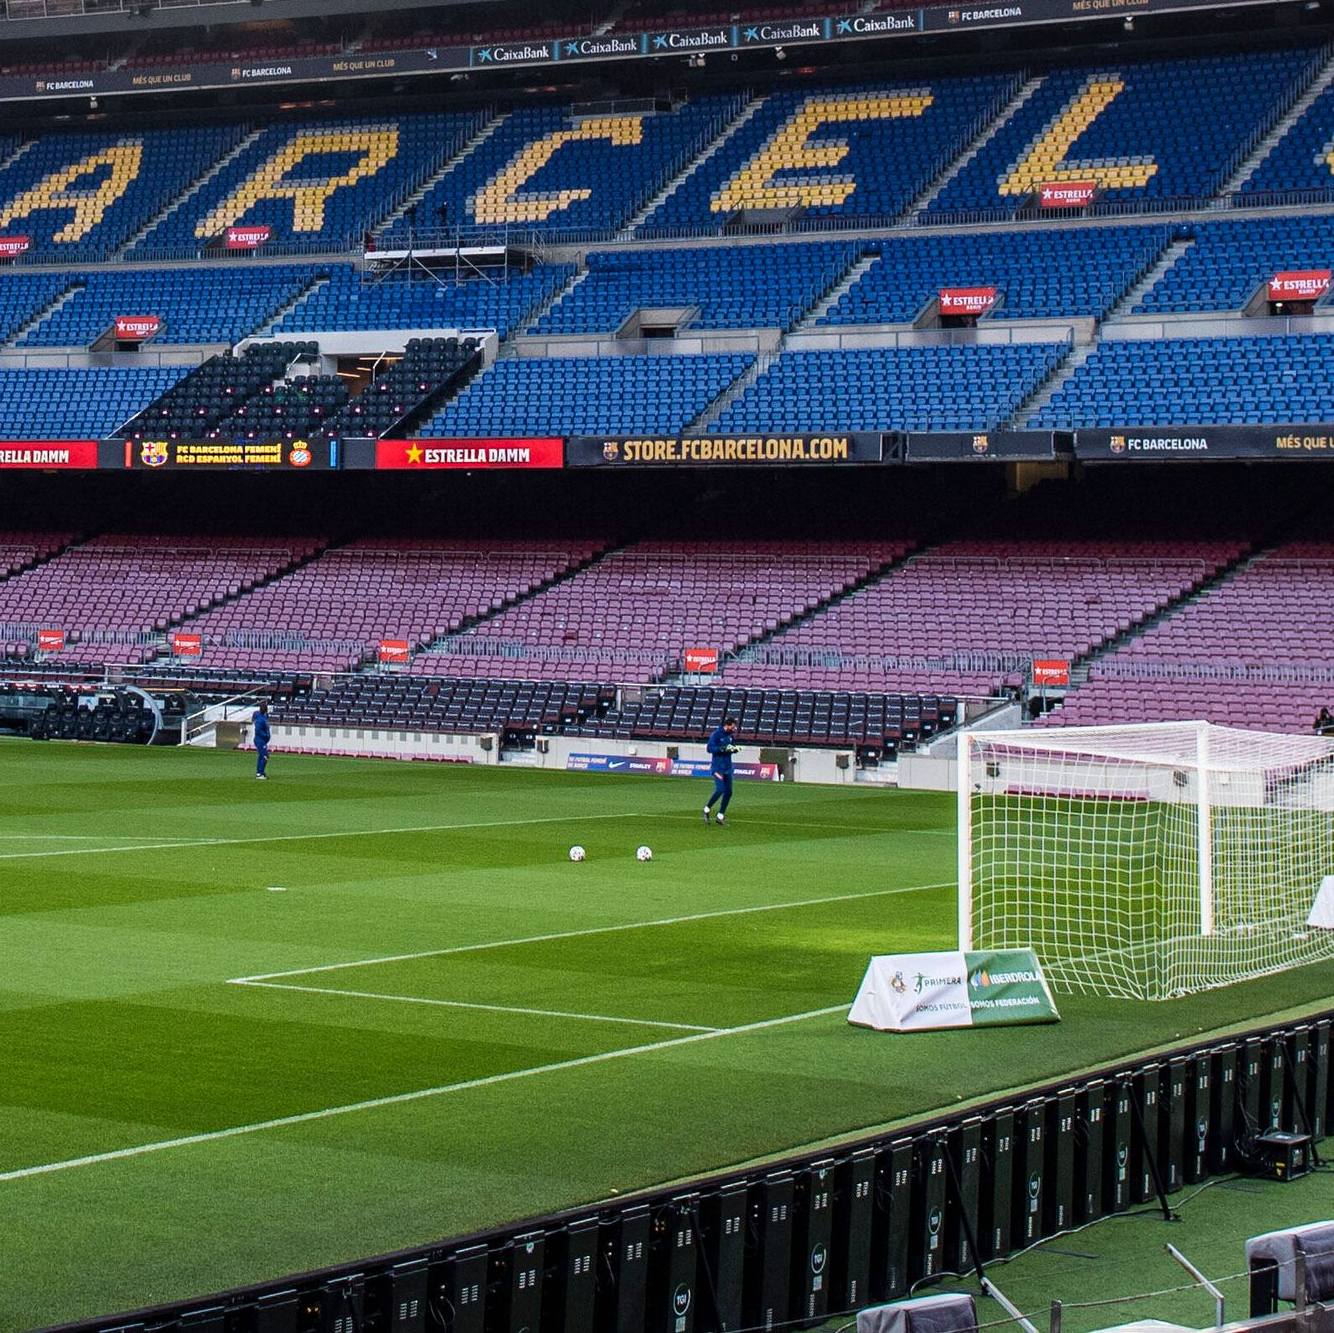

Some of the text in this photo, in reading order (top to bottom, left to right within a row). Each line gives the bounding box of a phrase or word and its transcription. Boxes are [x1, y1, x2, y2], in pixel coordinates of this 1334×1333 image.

[962, 7, 1021, 22] FC BARCELONA
[854, 16, 914, 32] CaixaBank
[761, 24, 820, 40] CaixaBank
[670, 32, 727, 47] CaixaBank
[581, 39, 637, 54] CaixaBank
[494, 47, 549, 62] CaixaBank
[252, 65, 291, 78] BARCELONA
[350, 61, 363, 70] QUE
[377, 60, 394, 70] CLUB
[56, 79, 93, 91] BARCELONA
[149, 75, 161, 85] QUE
[175, 73, 191, 83] CLUB
[1054, 189, 1093, 199] ESTRELLA
[1284, 278, 1330, 290] ESTRELLA
[953, 296, 994, 305] ESTRELLA
[1128, 439, 1207, 450] FC BARCELONA
[1277, 436, 1301, 448] MÉS
[1304, 437, 1327, 448] QUE
[190, 445, 243, 454] BARCELONA
[245, 444, 281, 454] FEMENÍ
[624, 438, 847, 460] STORE.FCBARCELONA.COM
[33, 450, 69, 463] DAMM
[177, 455, 195, 463] RCD
[197, 455, 243, 463] ESPANYOL
[425, 449, 530, 463] ESTRELLA DAMM
[924, 971, 1040, 986] PRIMERA IBERDROLA
[915, 1004, 939, 1012] SOMOS
[970, 999, 995, 1008] SOMOS
[996, 996, 1040, 1007] FEDERACIÓN
